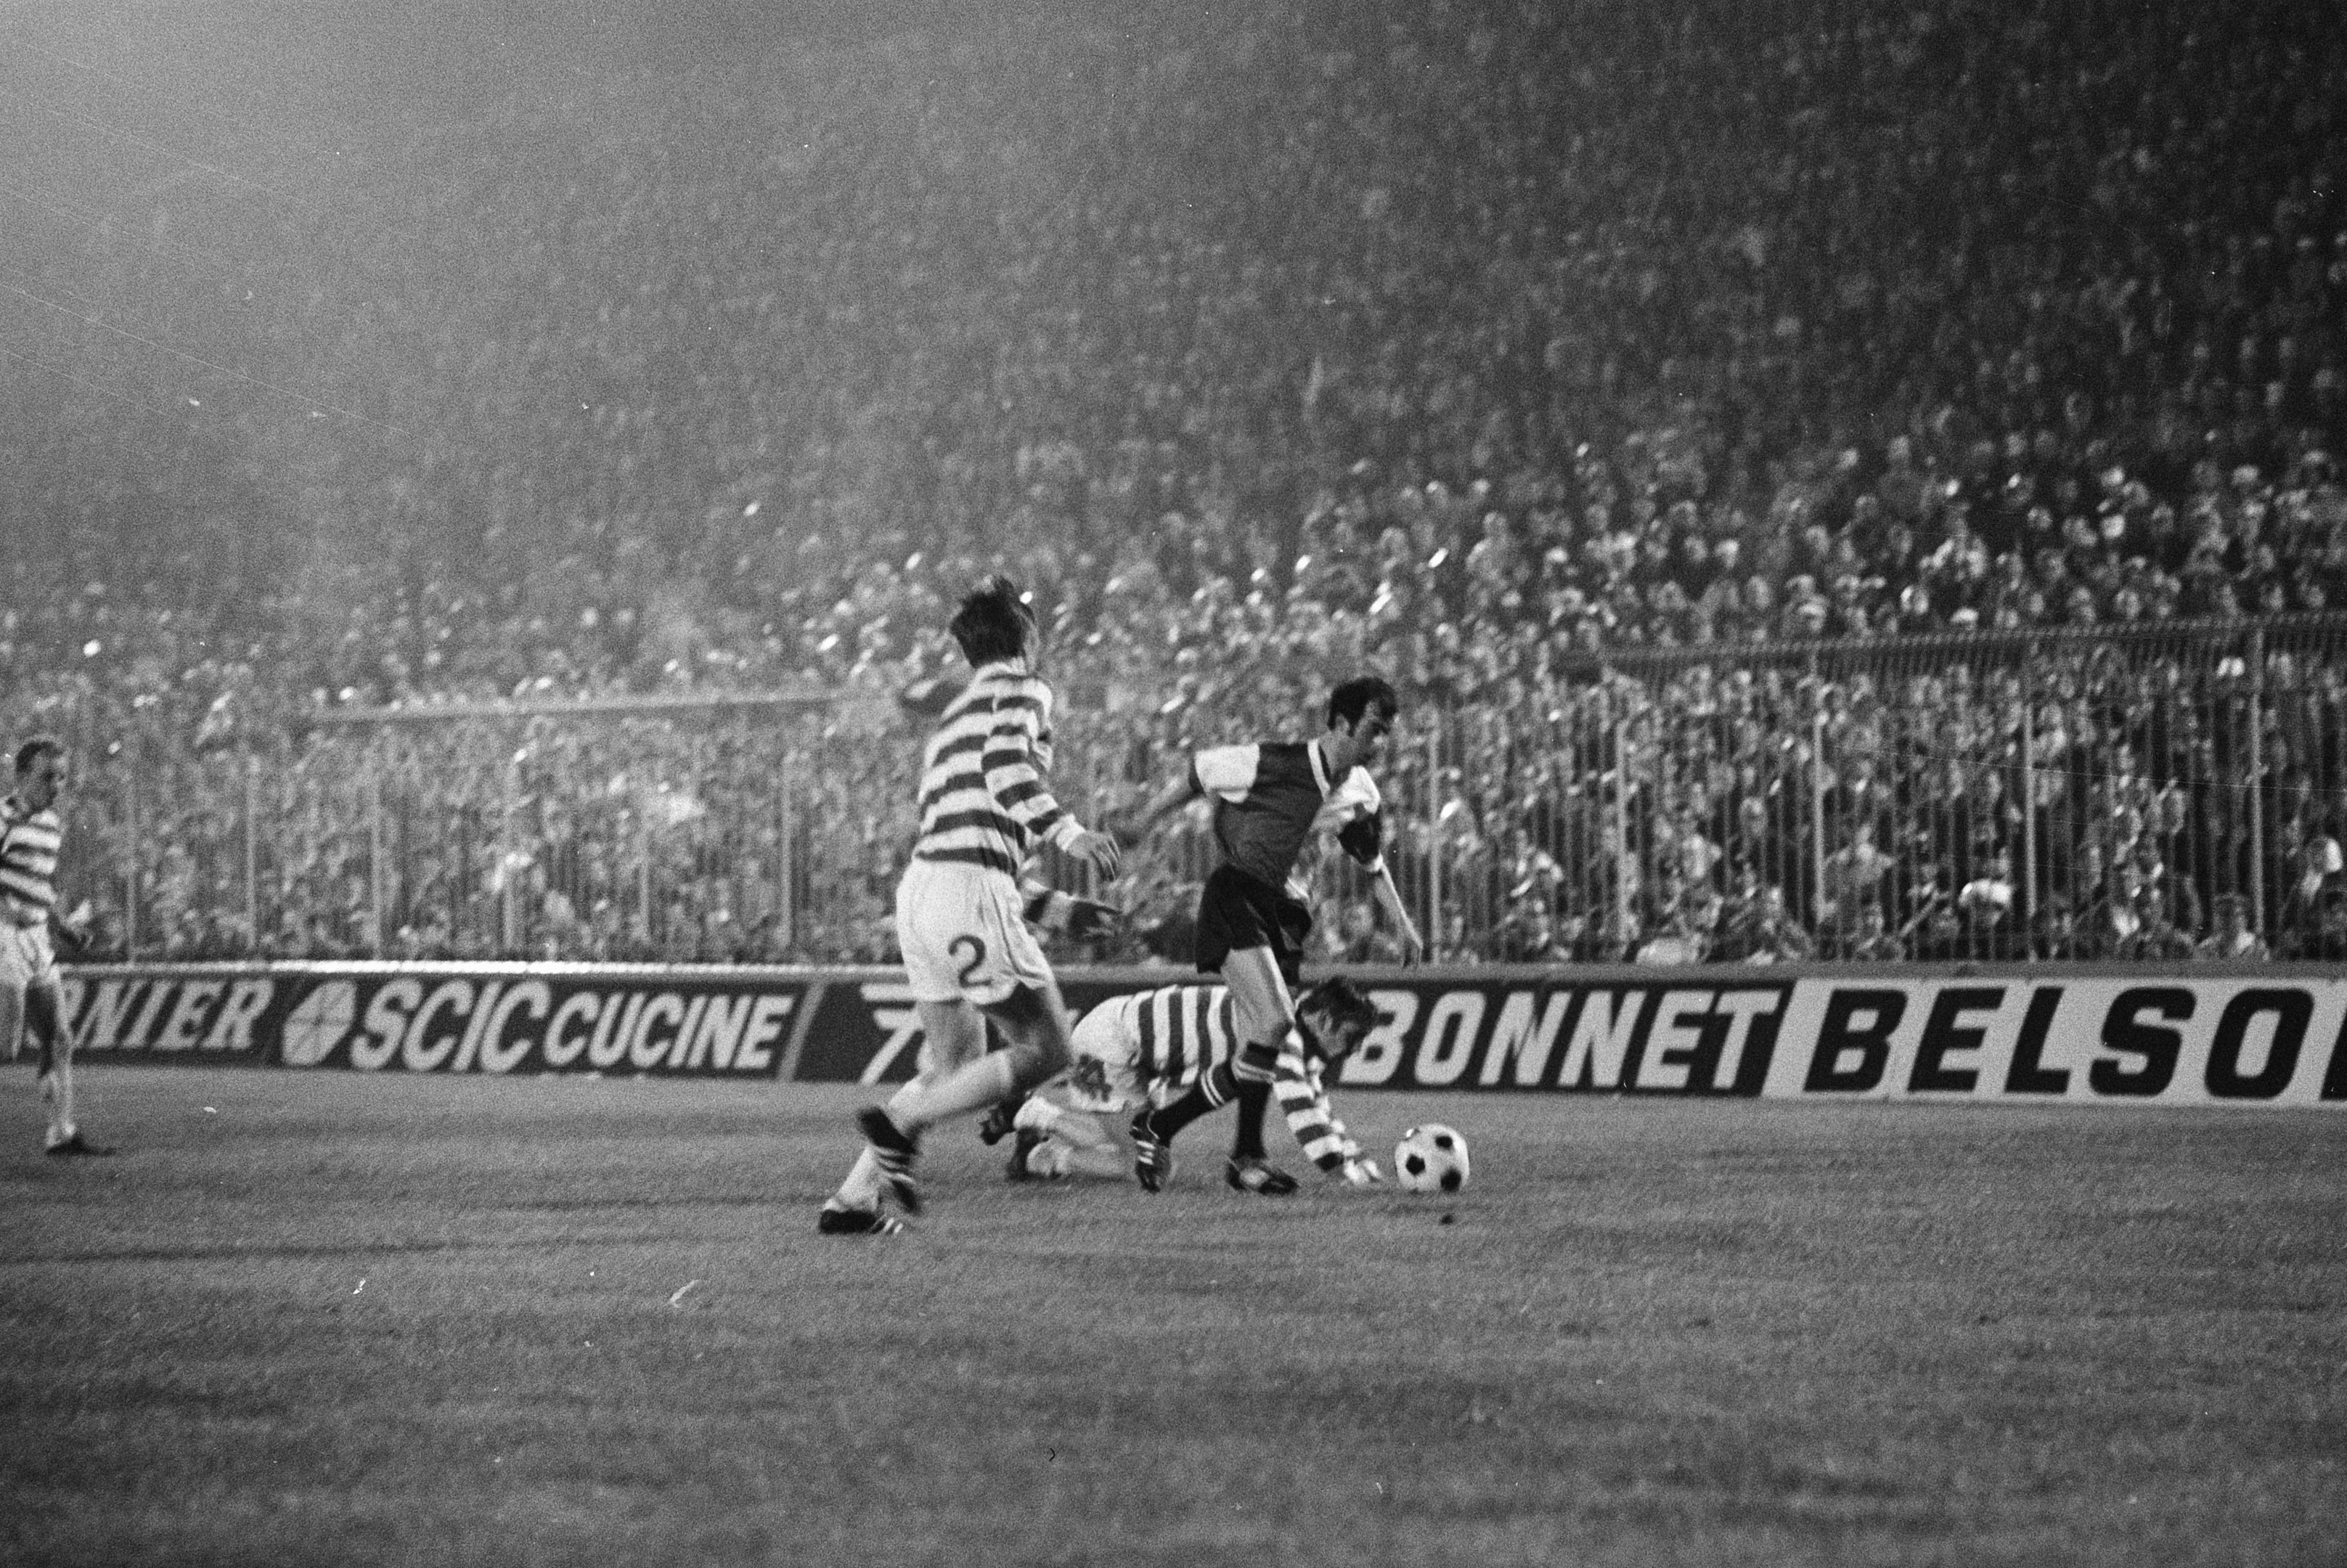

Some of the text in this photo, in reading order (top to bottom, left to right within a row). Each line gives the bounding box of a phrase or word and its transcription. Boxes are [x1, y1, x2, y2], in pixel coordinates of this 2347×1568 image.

[948, 934, 993, 989] 2
[351, 979, 551, 1072] SCIC
[543, 992, 794, 1069] CUCINE
[1339, 990, 1781, 1089] BONNET
[1803, 987, 2347, 1101] BELSO
